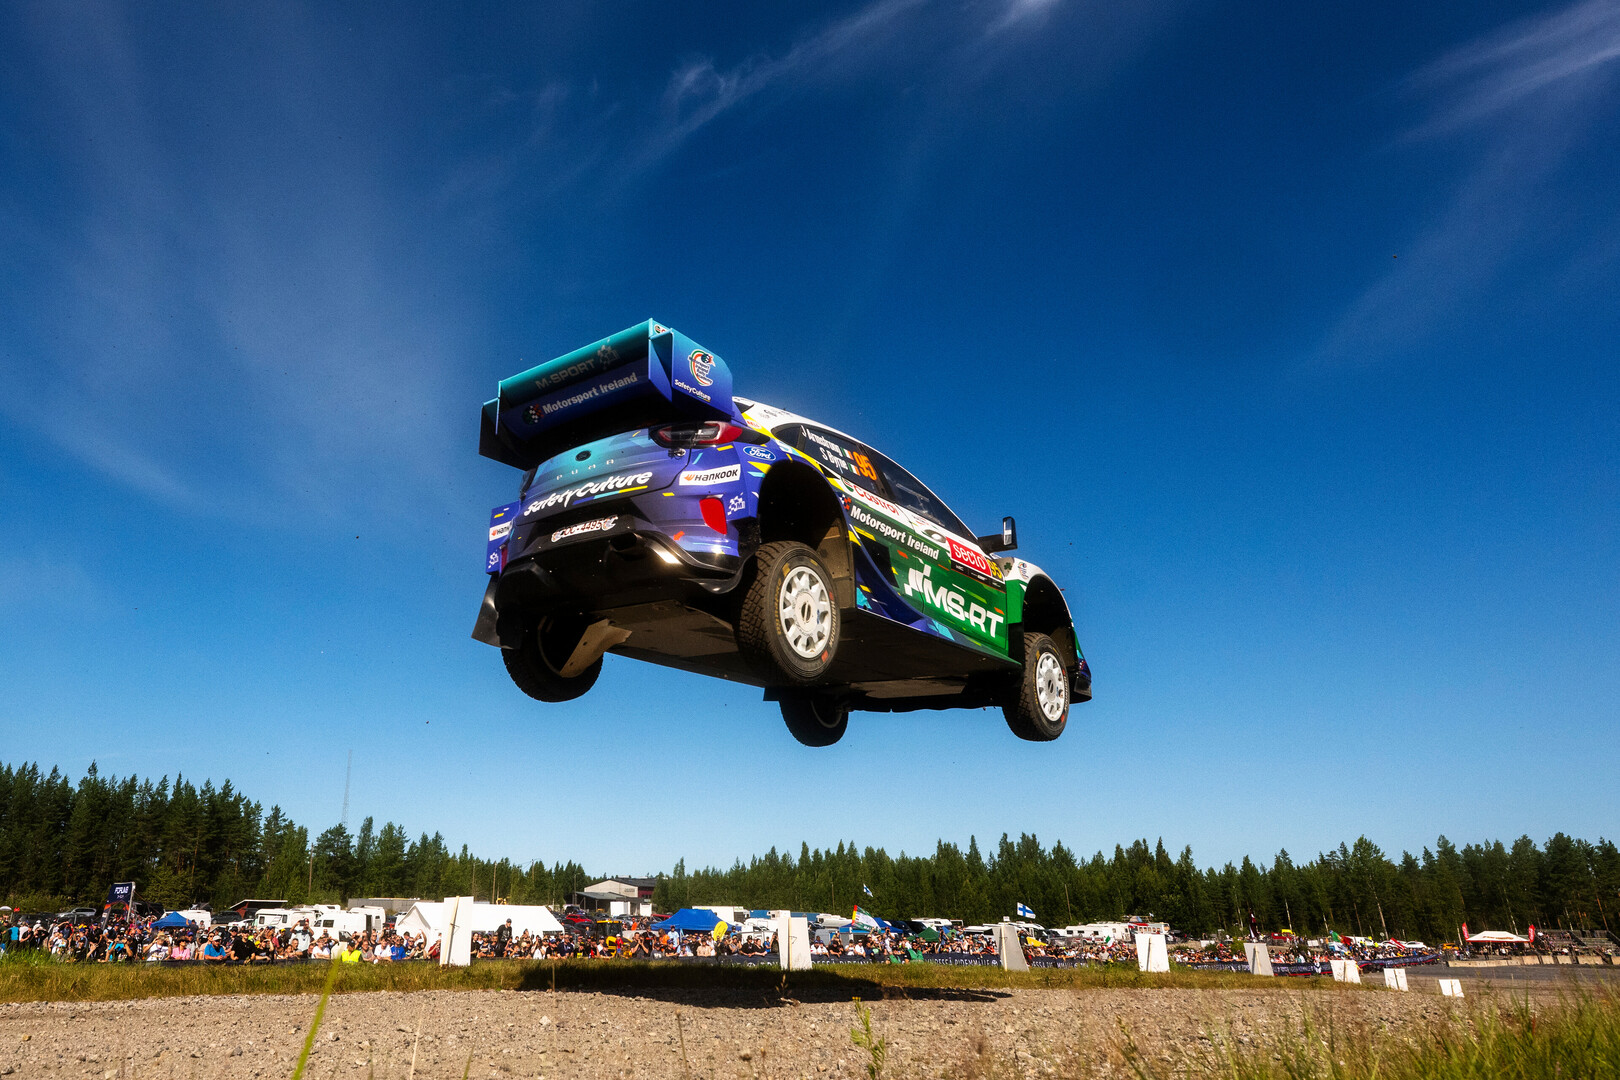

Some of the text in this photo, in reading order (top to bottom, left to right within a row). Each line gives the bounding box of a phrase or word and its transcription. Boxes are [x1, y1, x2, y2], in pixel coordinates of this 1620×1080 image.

[542, 372, 638, 414] Motorsport Ireland
[674, 379, 711, 401] SafetyCulture
[819, 447, 828, 461] S
[852, 451, 877, 480] 95
[694, 469, 738, 482] HANKOOK
[524, 471, 653, 516] SafetyCulture
[853, 484, 900, 516] Castrol
[850, 505, 907, 544] Motorsport
[907, 535, 940, 560] Ireland
[952, 543, 986, 570] secto
[923, 577, 1004, 638] MS-RT
